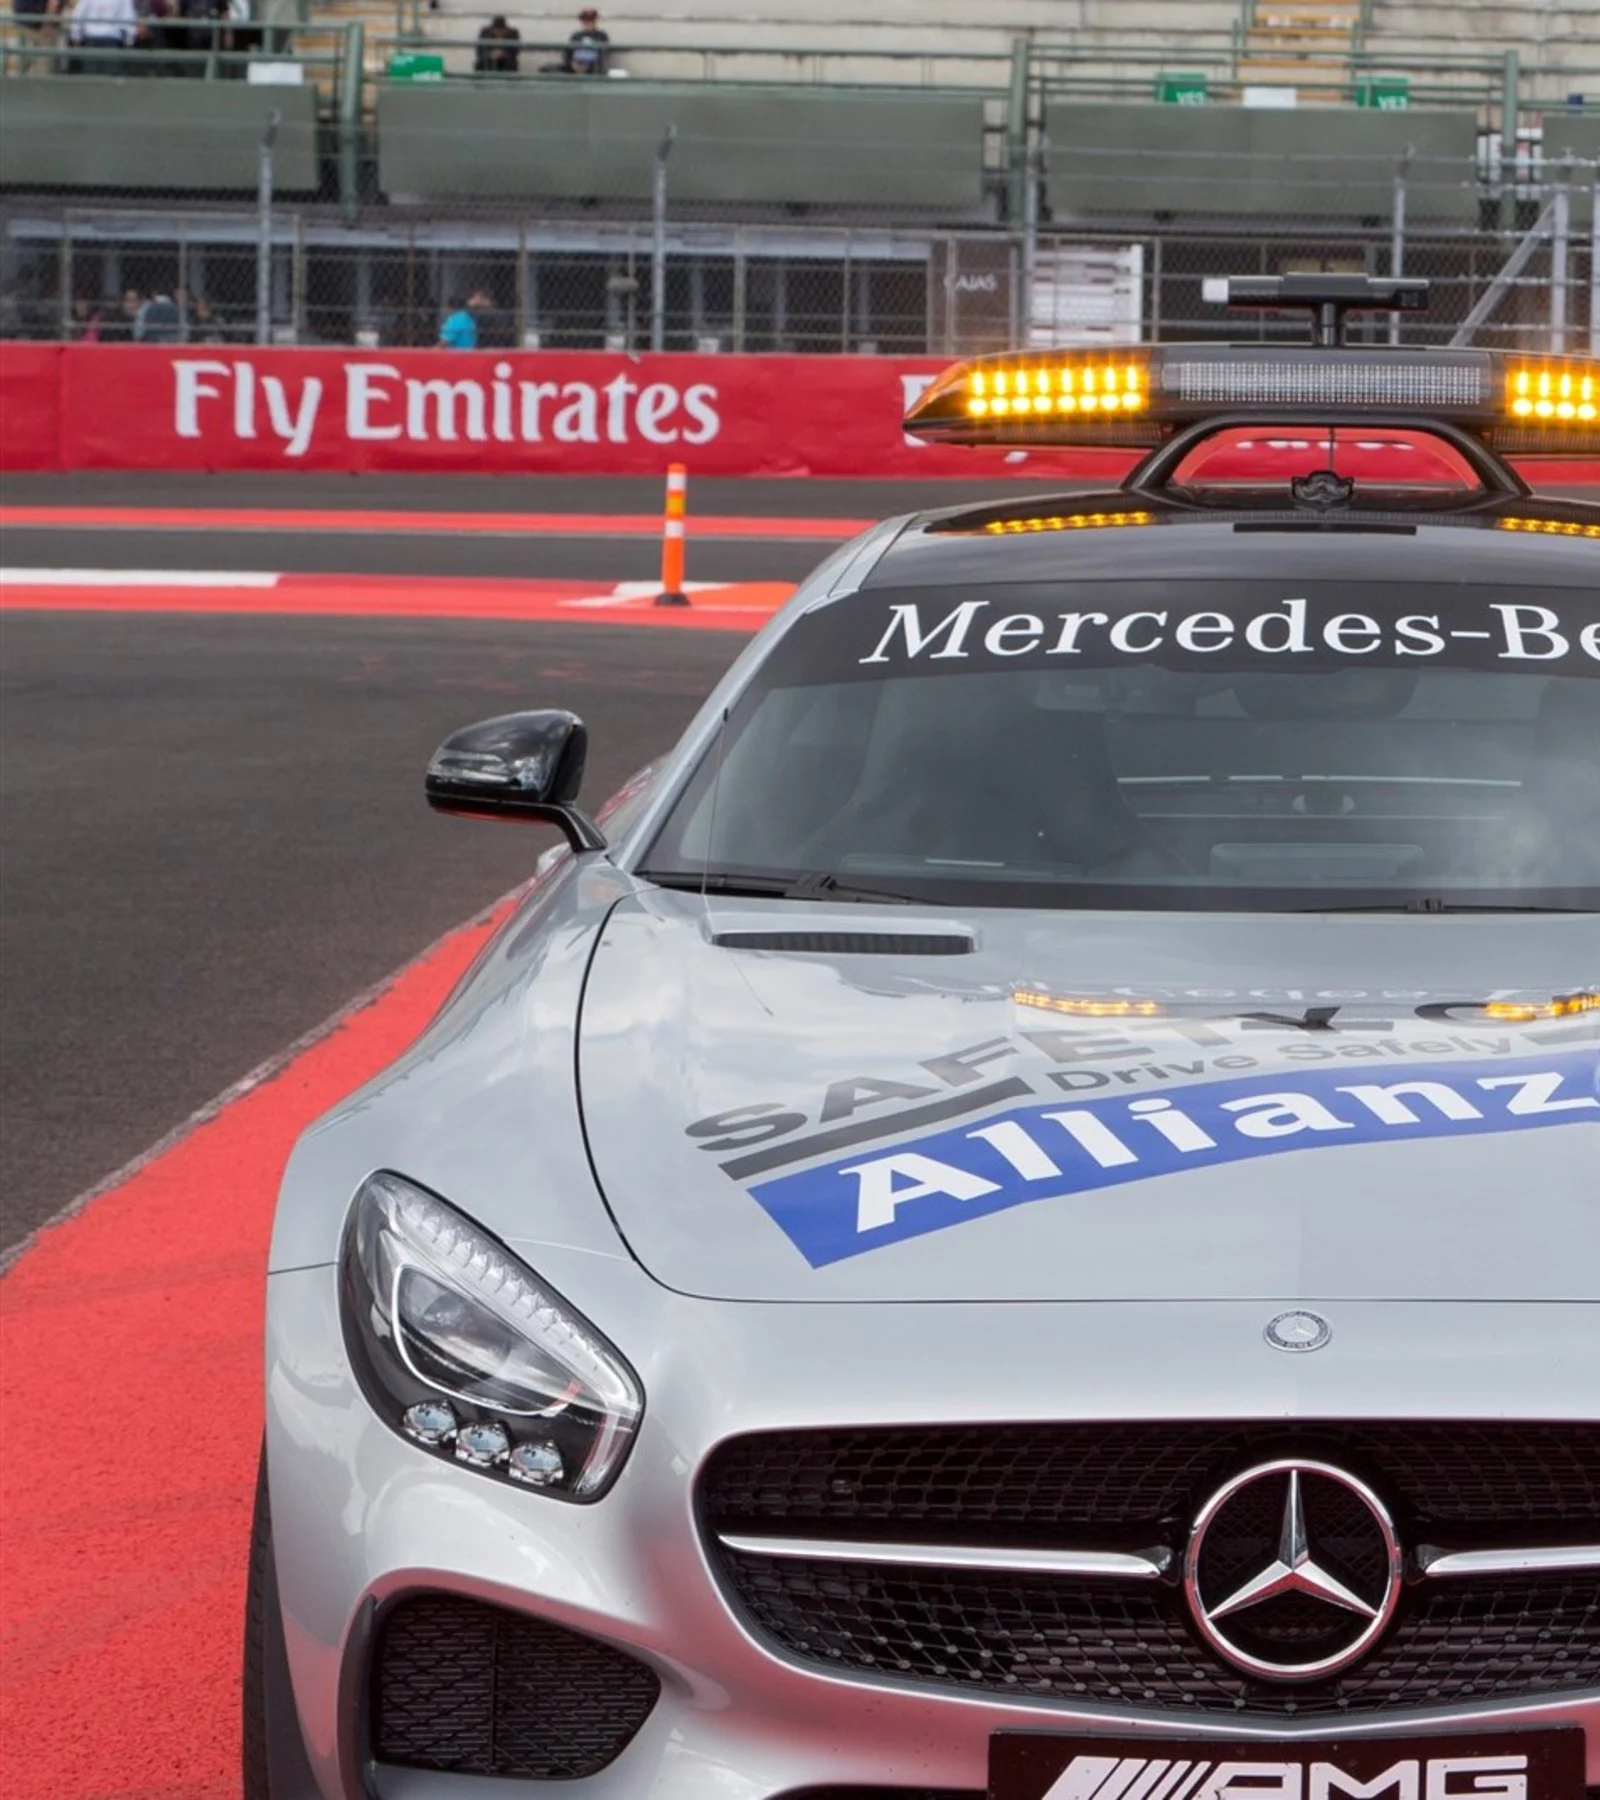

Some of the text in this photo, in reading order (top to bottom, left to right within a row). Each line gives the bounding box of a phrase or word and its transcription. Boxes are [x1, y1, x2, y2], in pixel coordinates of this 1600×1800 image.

[172, 360, 721, 456] Fly Emirates
[685, 1005, 1346, 1152] SAFETY
[1046, 1019, 1512, 1093] Drive Safely
[838, 1071, 1600, 1234] Allianz
[1197, 1756, 1528, 1800] AMG
